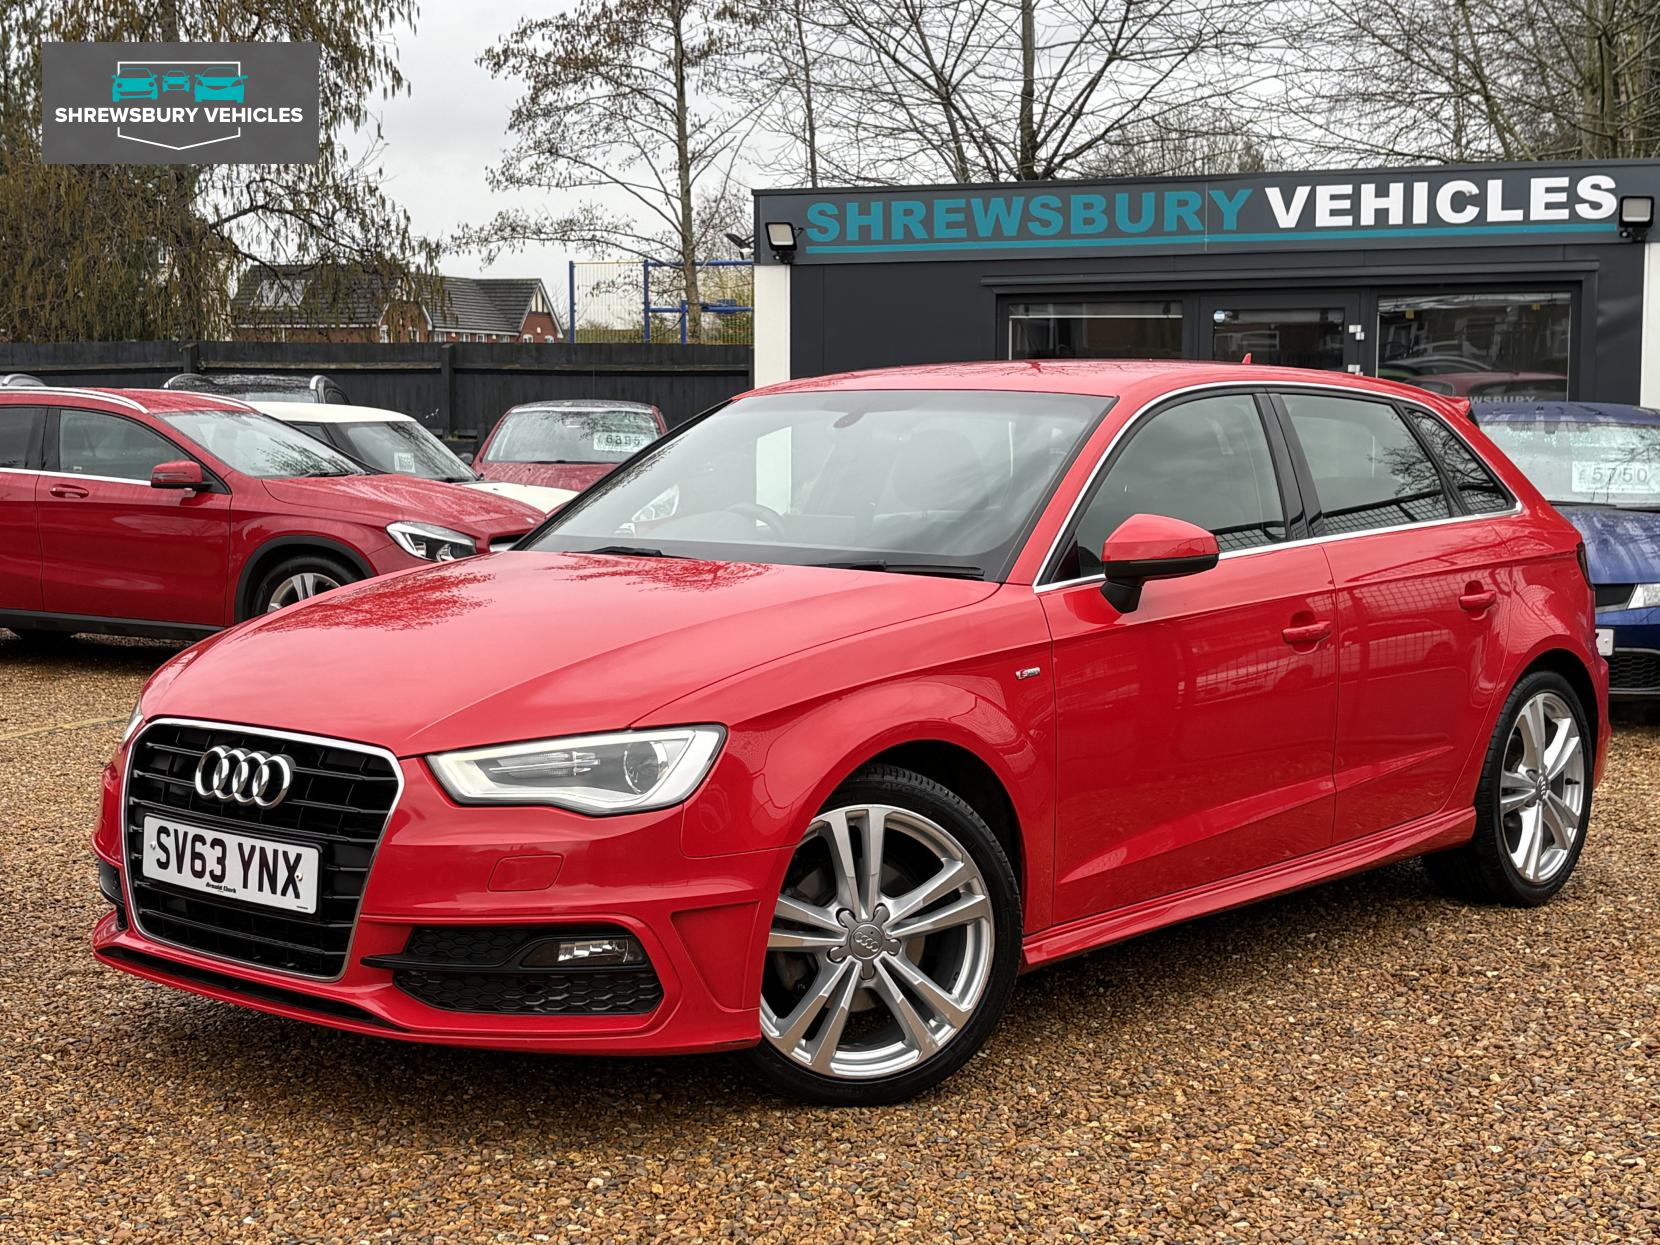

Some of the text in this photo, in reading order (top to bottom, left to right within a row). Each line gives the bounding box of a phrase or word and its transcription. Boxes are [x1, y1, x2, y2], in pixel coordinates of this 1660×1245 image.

[806, 174, 1618, 242] SHREWSBURY VEHICLES
[155, 825, 303, 900] SV63 YNX
